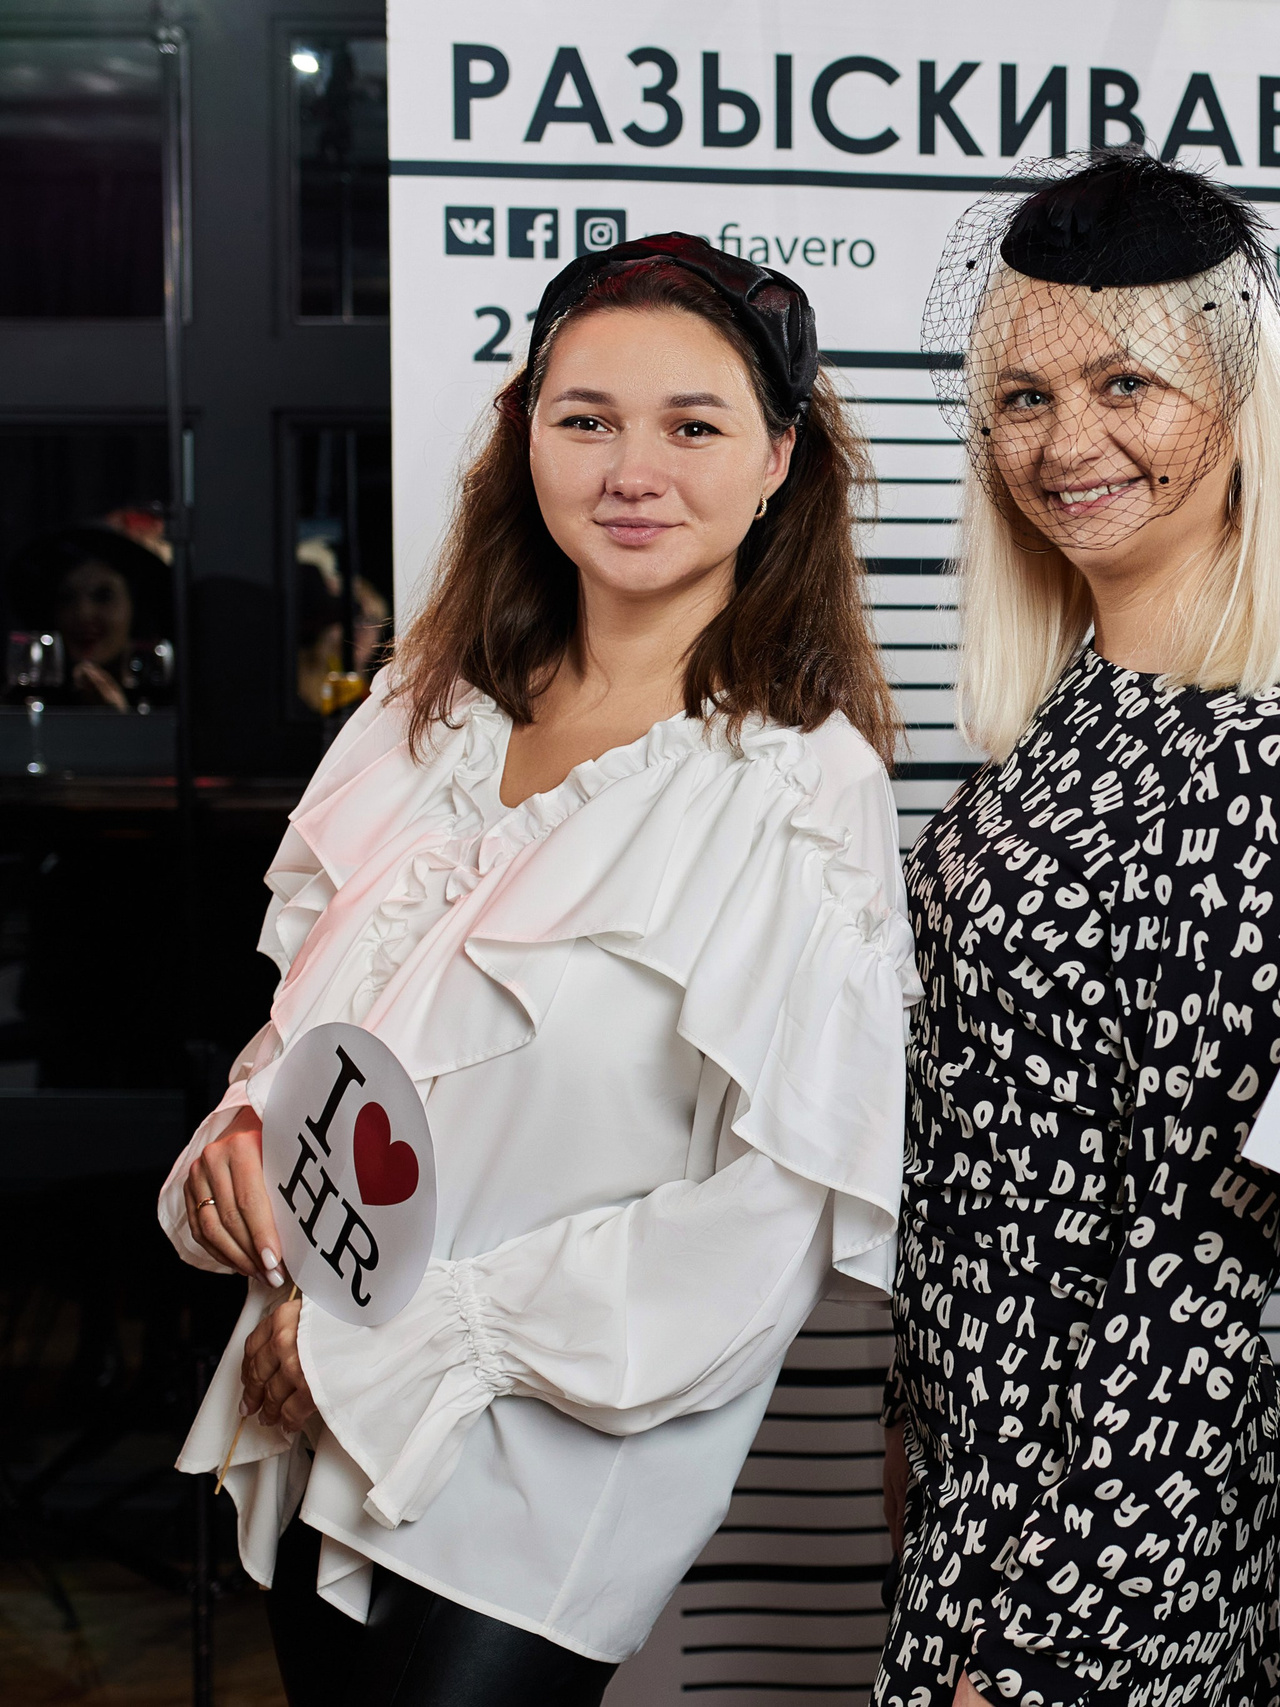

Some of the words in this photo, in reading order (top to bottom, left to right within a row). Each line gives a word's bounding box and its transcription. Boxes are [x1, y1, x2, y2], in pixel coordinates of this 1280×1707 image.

[643, 222, 876, 269] fiavero
[305, 1044, 366, 1158] I
[277, 1132, 380, 1308] HR
